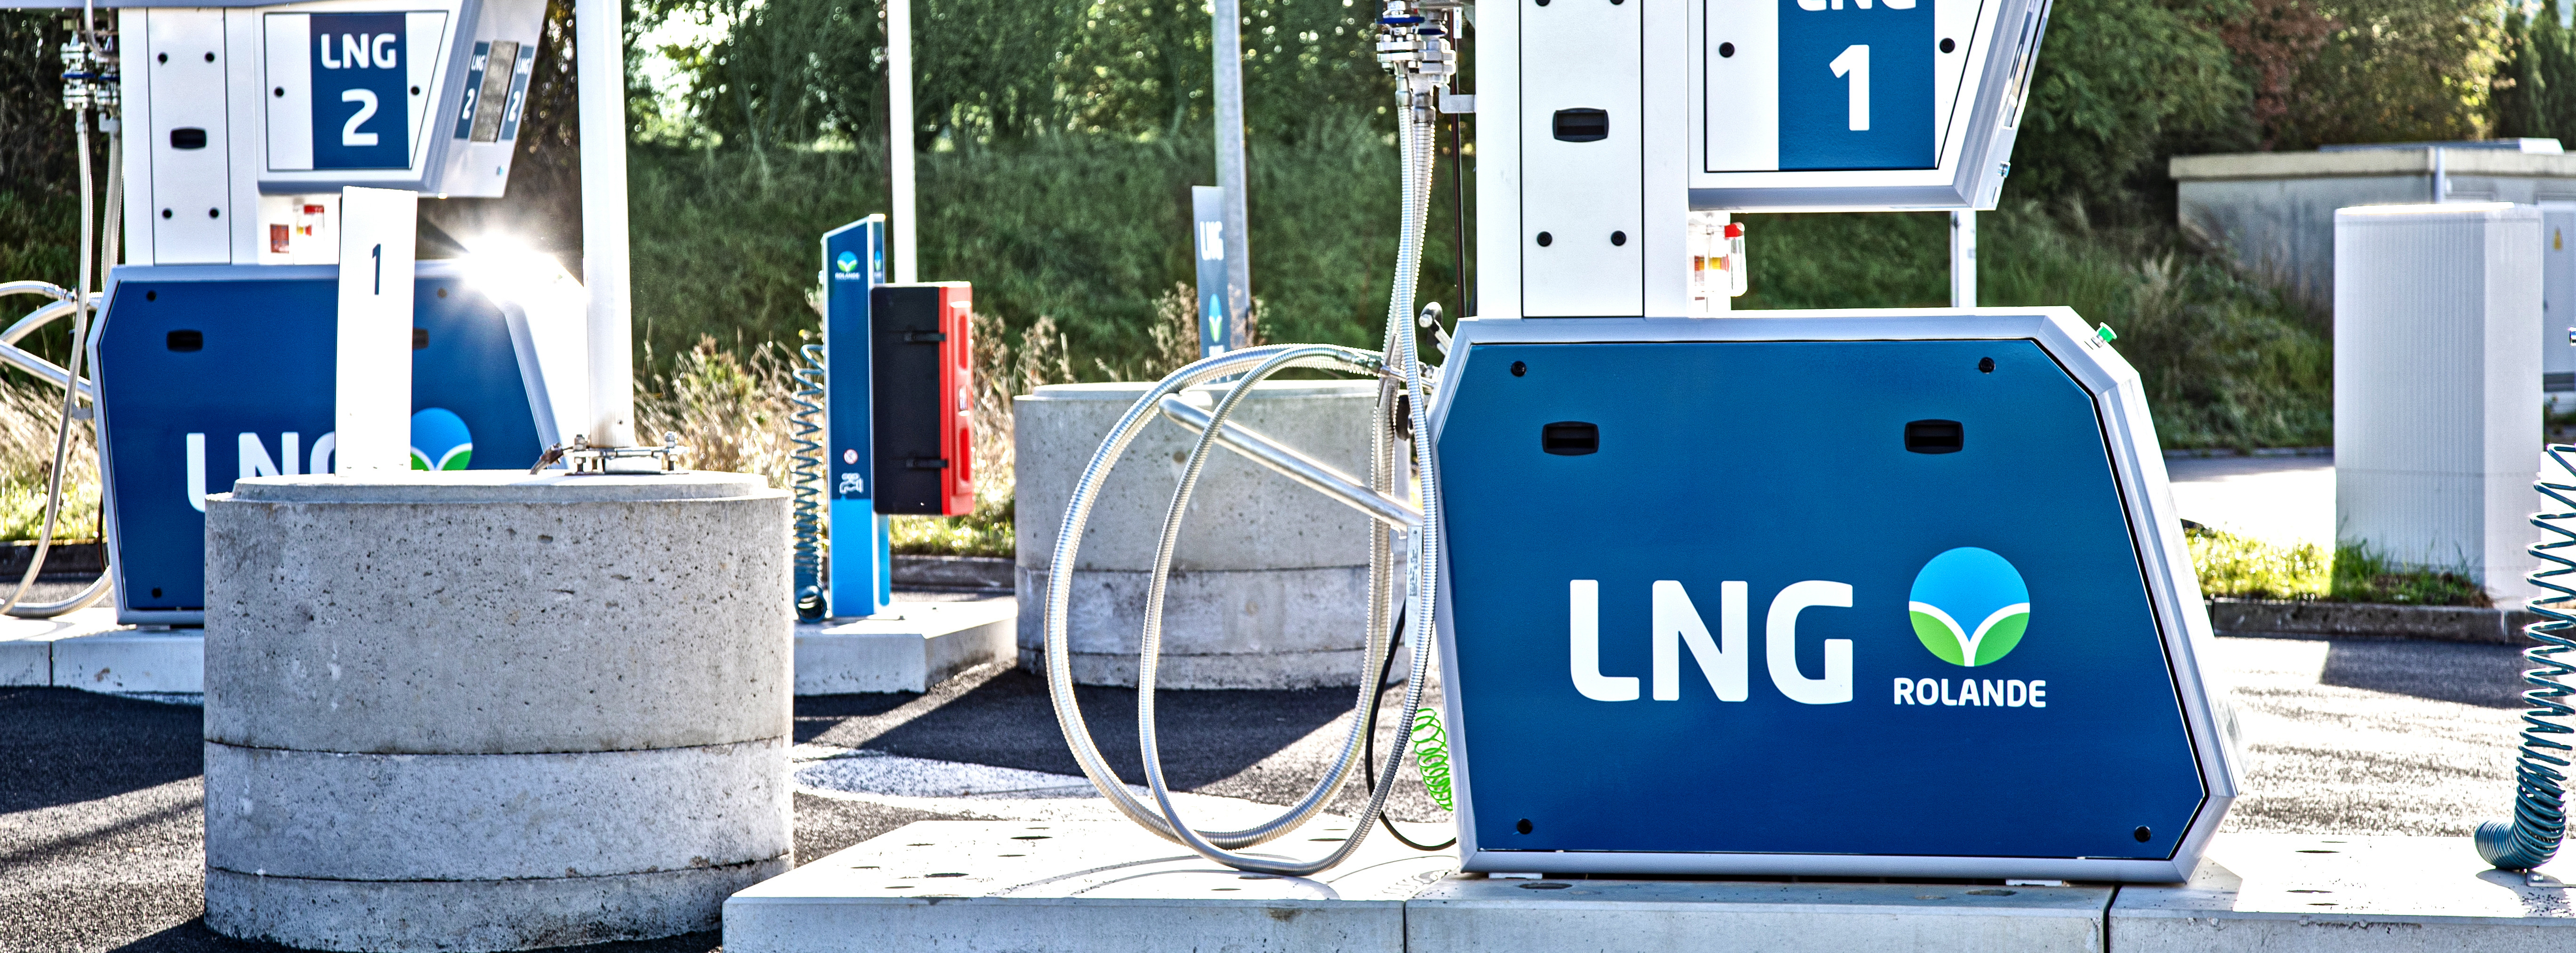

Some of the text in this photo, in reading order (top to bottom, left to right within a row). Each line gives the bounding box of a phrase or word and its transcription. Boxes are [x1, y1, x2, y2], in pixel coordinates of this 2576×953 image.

[321, 33, 397, 69] LNG
[471, 55, 485, 71] LNG
[517, 58, 531, 75] LNG
[462, 88, 475, 120] 2
[1829, 44, 1870, 130] 1
[342, 89, 378, 146] 2
[508, 90, 521, 122] 2
[372, 243, 381, 295] 1
[187, 431, 335, 512] LN
[1570, 580, 1853, 704] LNG
[1894, 677, 2046, 708] ROLANDE
